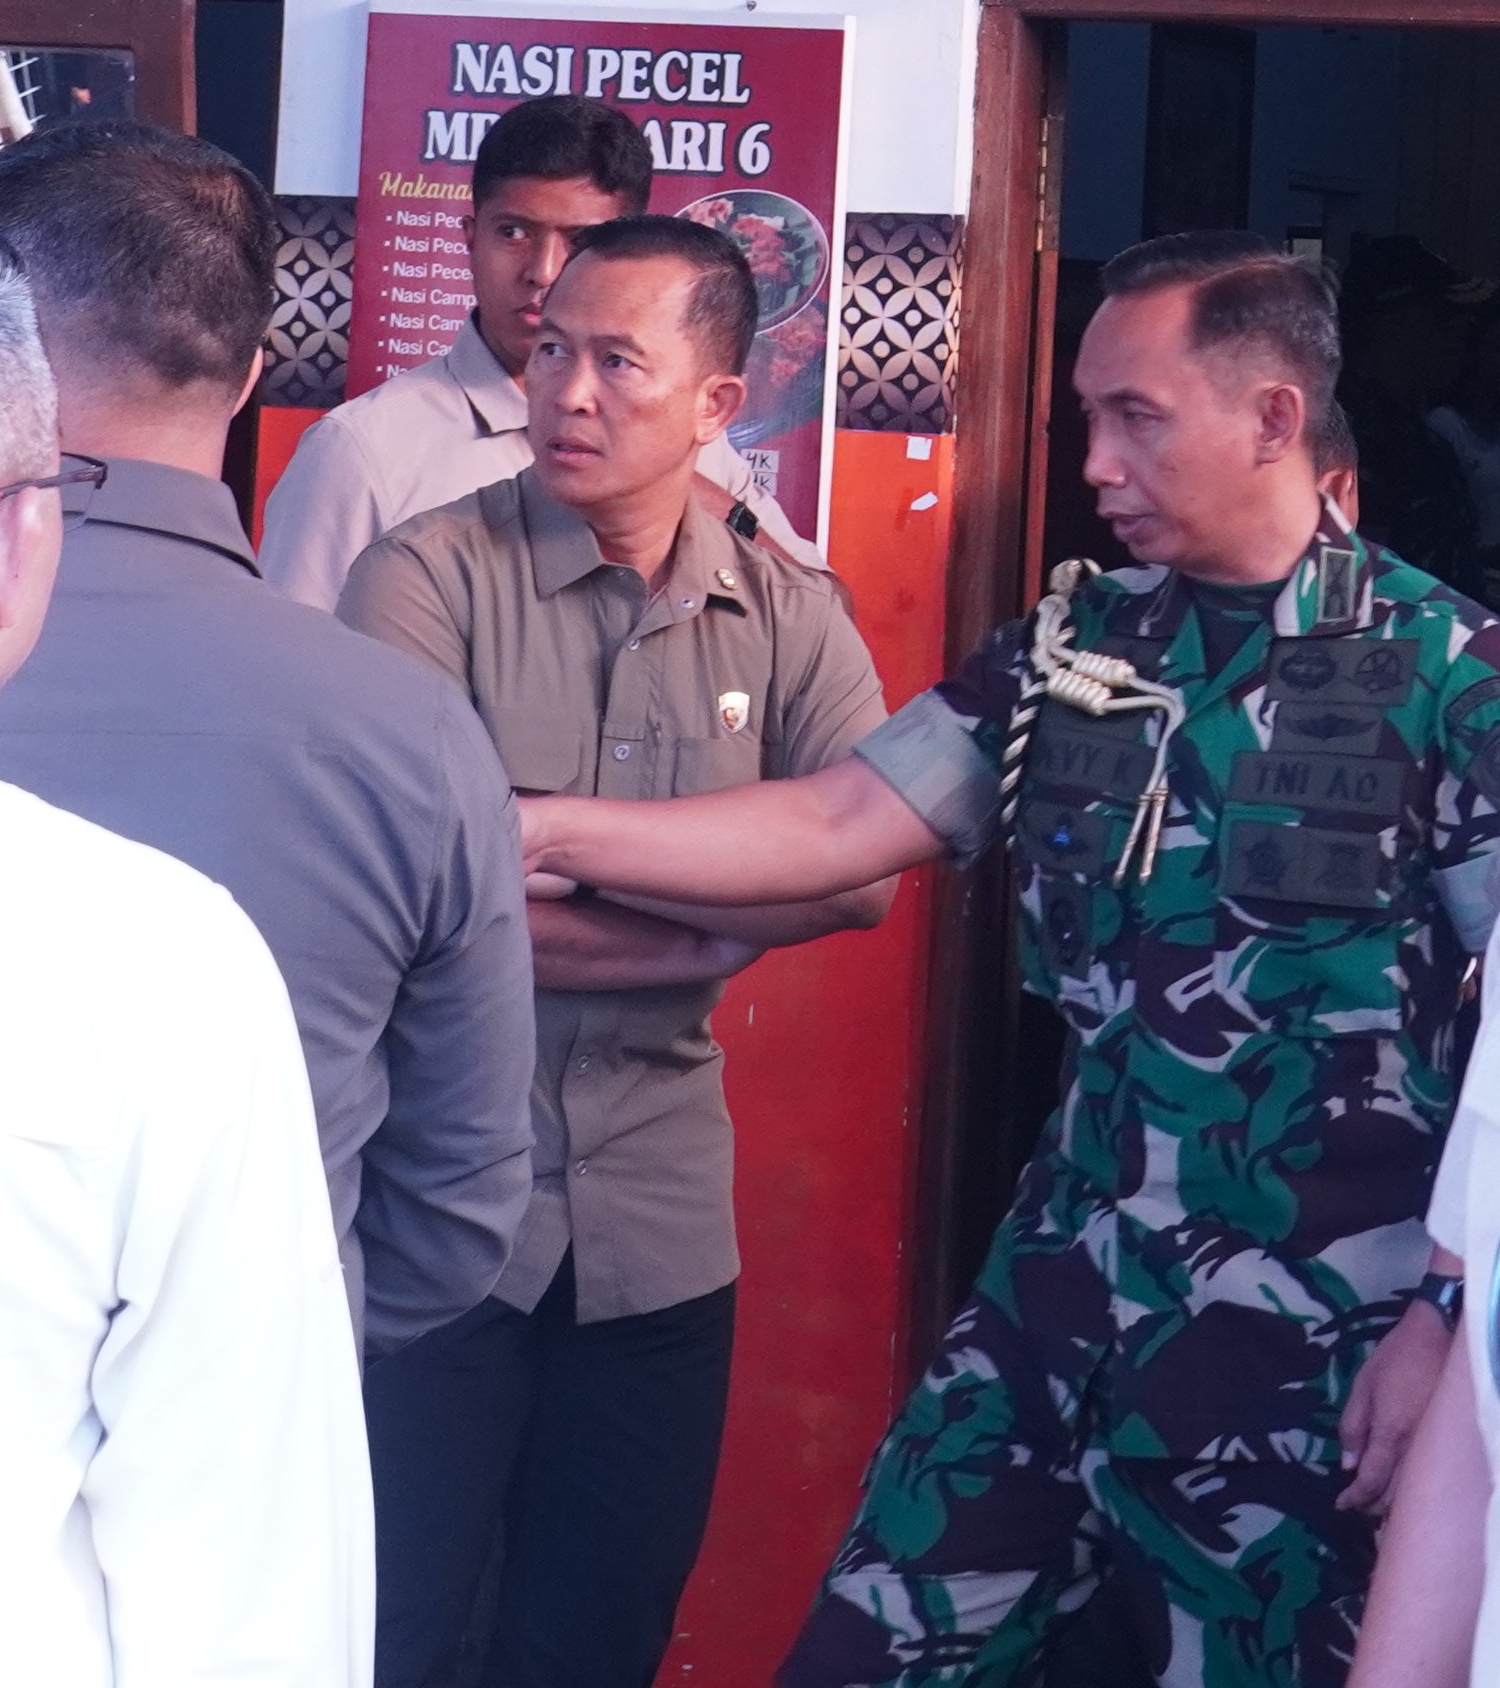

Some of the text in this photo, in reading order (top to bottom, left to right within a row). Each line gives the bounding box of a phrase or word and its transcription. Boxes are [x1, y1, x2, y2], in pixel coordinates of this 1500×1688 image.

[453, 43, 750, 104] NASI PECEL
[643, 119, 727, 172] ARI
[738, 122, 771, 175] 6
[379, 171, 473, 201] Makana
[396, 210, 431, 226] Nasi
[395, 235, 430, 252] Nasi
[393, 261, 474, 280] Nasi Pece
[391, 286, 426, 303] Nasi
[389, 313, 425, 329] Nasi
[388, 338, 423, 355] Nasi
[1254, 760, 1311, 795] TNI
